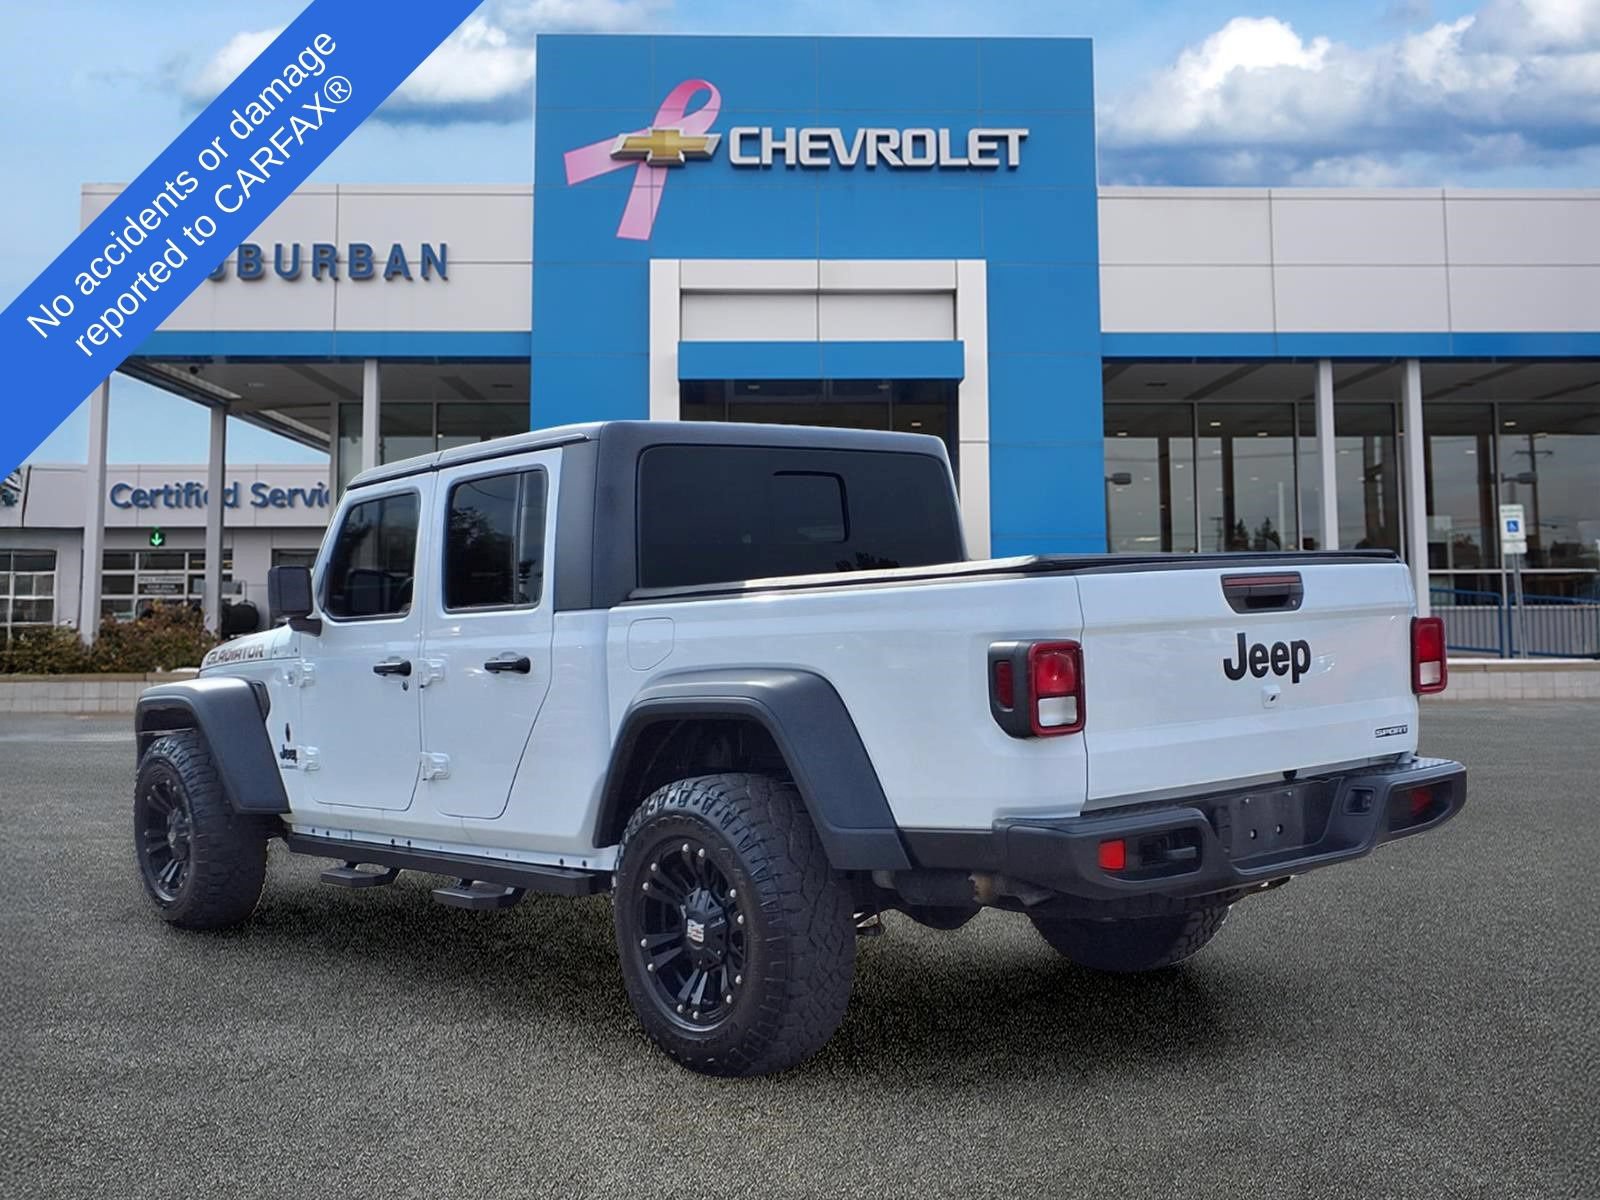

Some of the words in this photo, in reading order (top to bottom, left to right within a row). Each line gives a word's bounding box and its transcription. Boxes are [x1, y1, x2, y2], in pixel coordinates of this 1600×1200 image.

[728, 126, 1029, 169] CHEVROLET
[208, 242, 449, 282] BURBAN
[109, 481, 241, 510] Certifid
[250, 482, 331, 510] Servi
[1222, 631, 1312, 685] Jeep
[279, 743, 298, 765] Jeep
